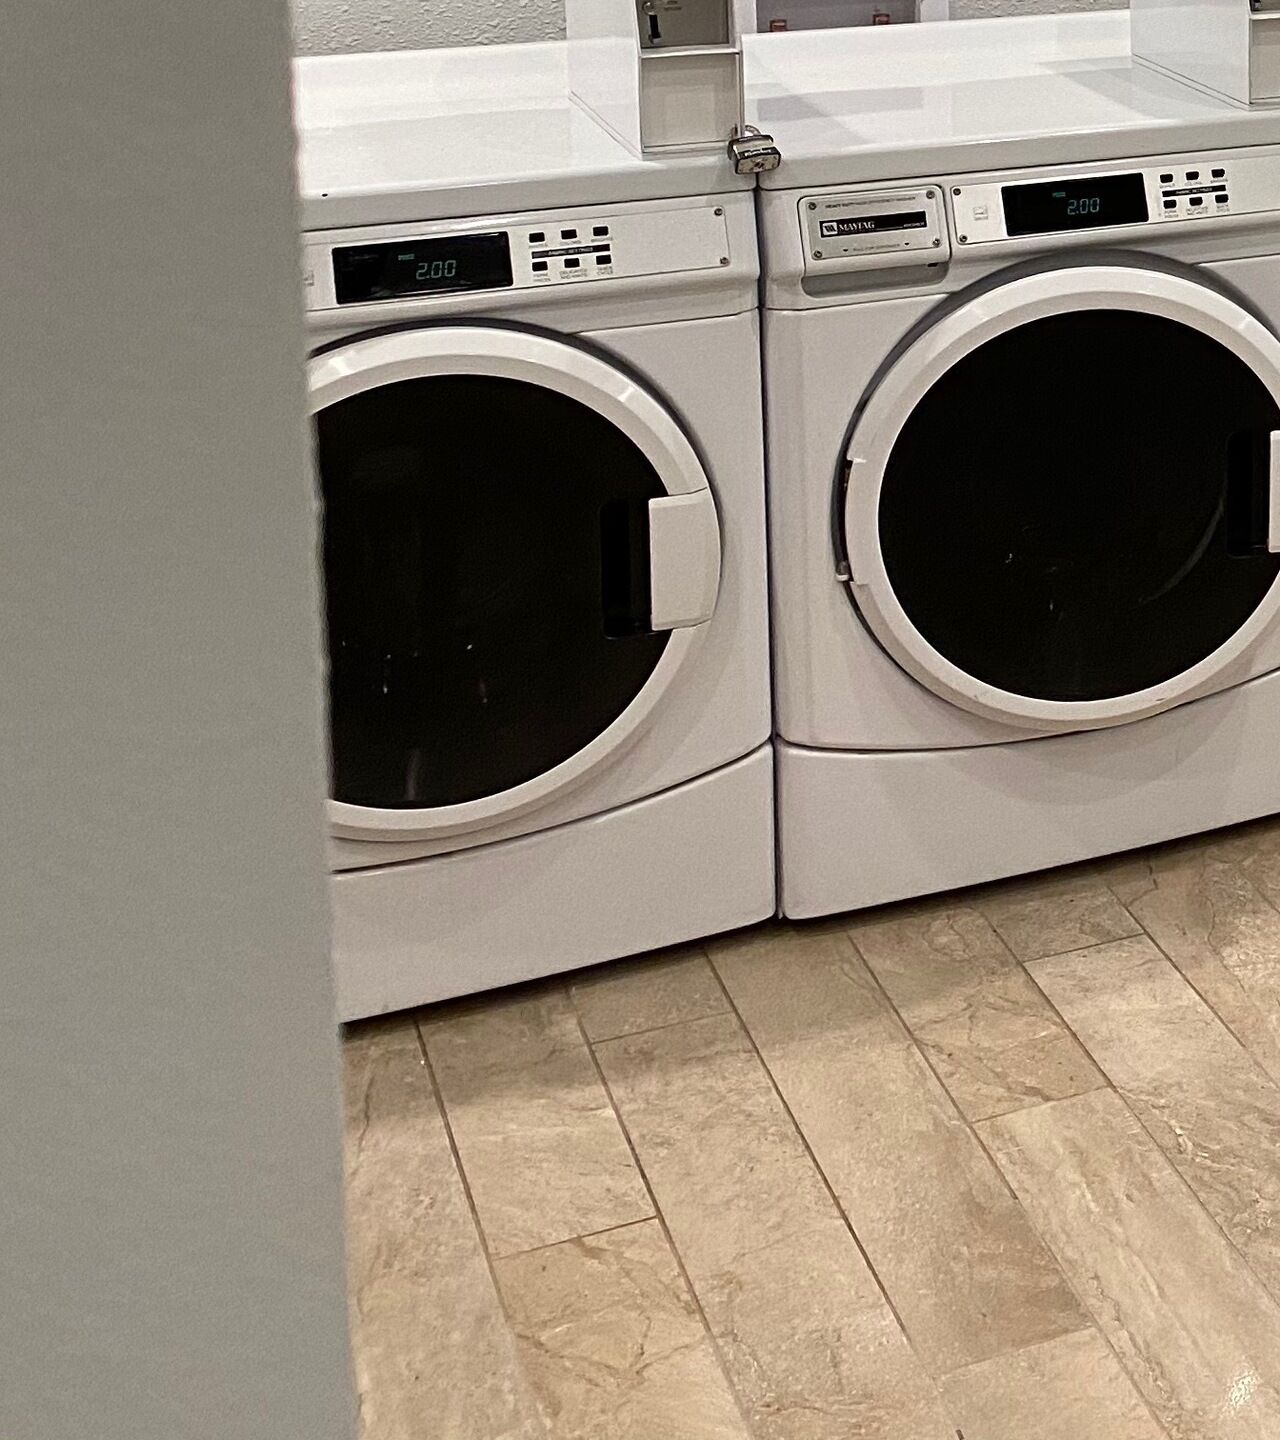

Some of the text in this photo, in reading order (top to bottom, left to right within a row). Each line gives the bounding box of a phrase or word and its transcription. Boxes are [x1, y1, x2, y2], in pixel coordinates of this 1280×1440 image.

[1066, 197, 1100, 216] 2.00
[838, 220, 875, 233] MAYTAG
[415, 259, 457, 281] 2.00
